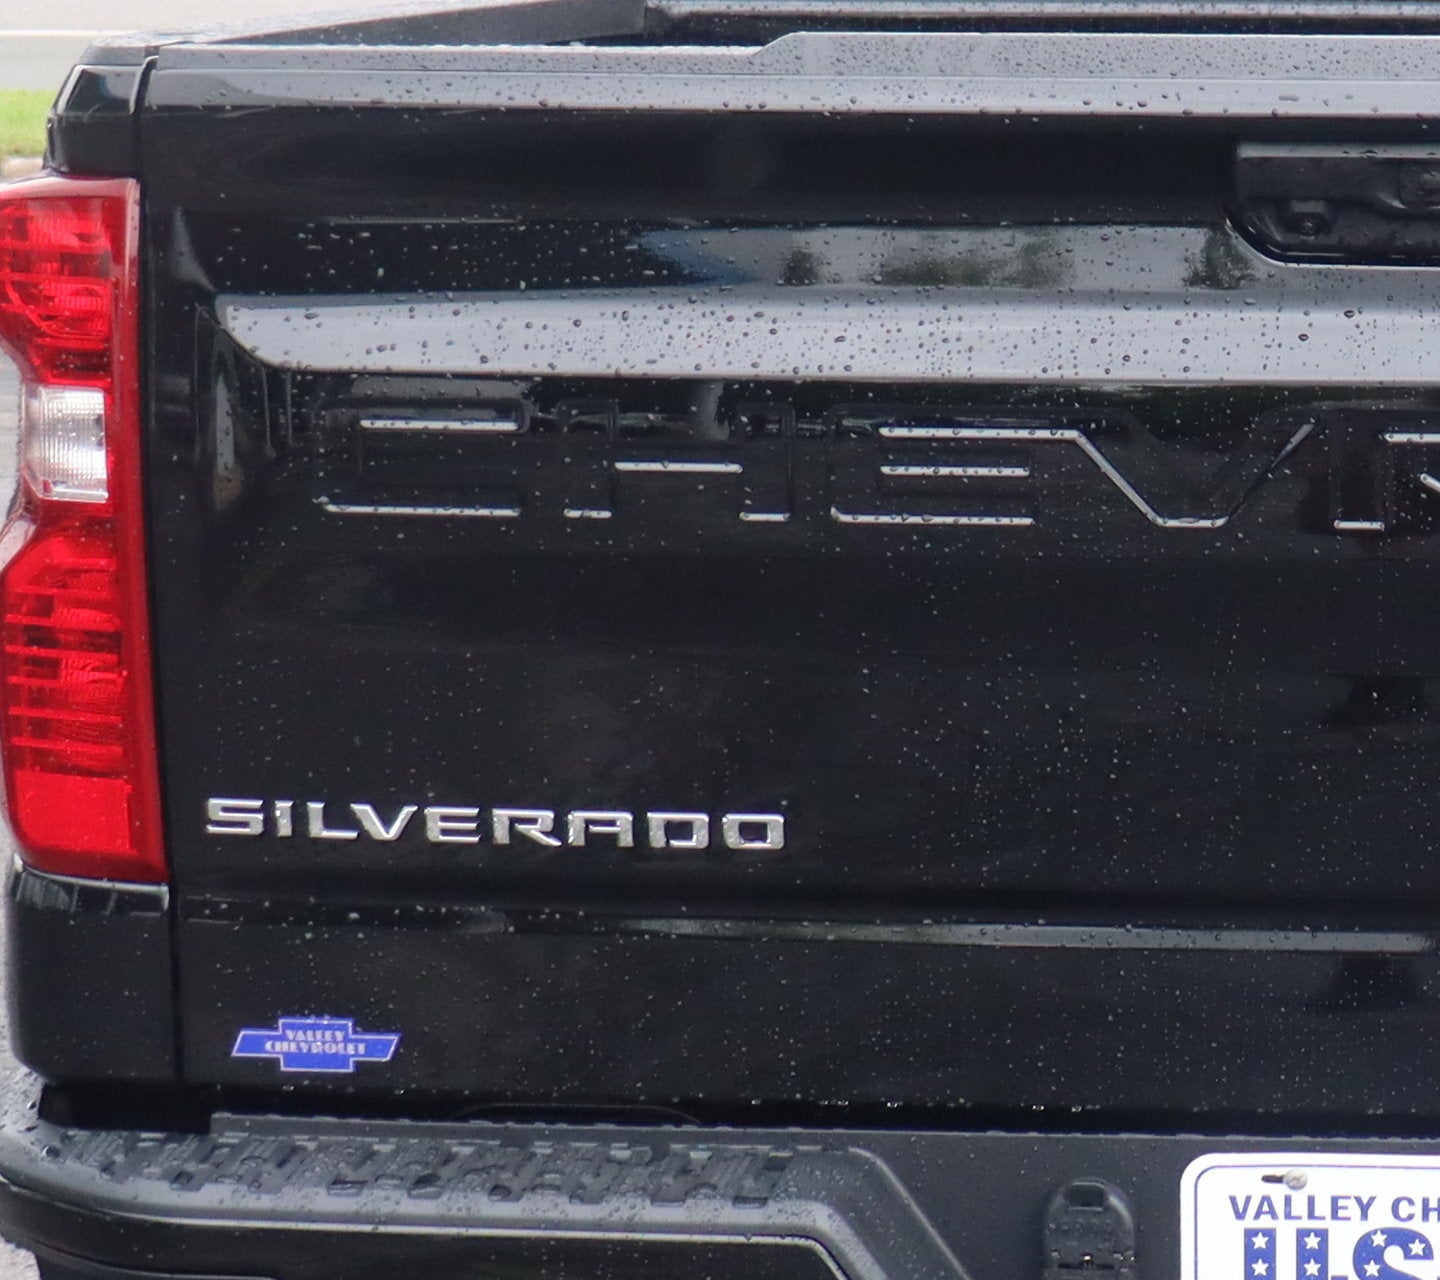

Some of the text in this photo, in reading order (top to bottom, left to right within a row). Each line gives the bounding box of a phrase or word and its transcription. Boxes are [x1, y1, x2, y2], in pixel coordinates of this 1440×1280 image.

[205, 797, 786, 850] SILVERADO
[285, 1029, 345, 1042] VALLEY
[264, 1040, 366, 1055] CHEVROLET
[1228, 1194, 1377, 1221] VALLEY
